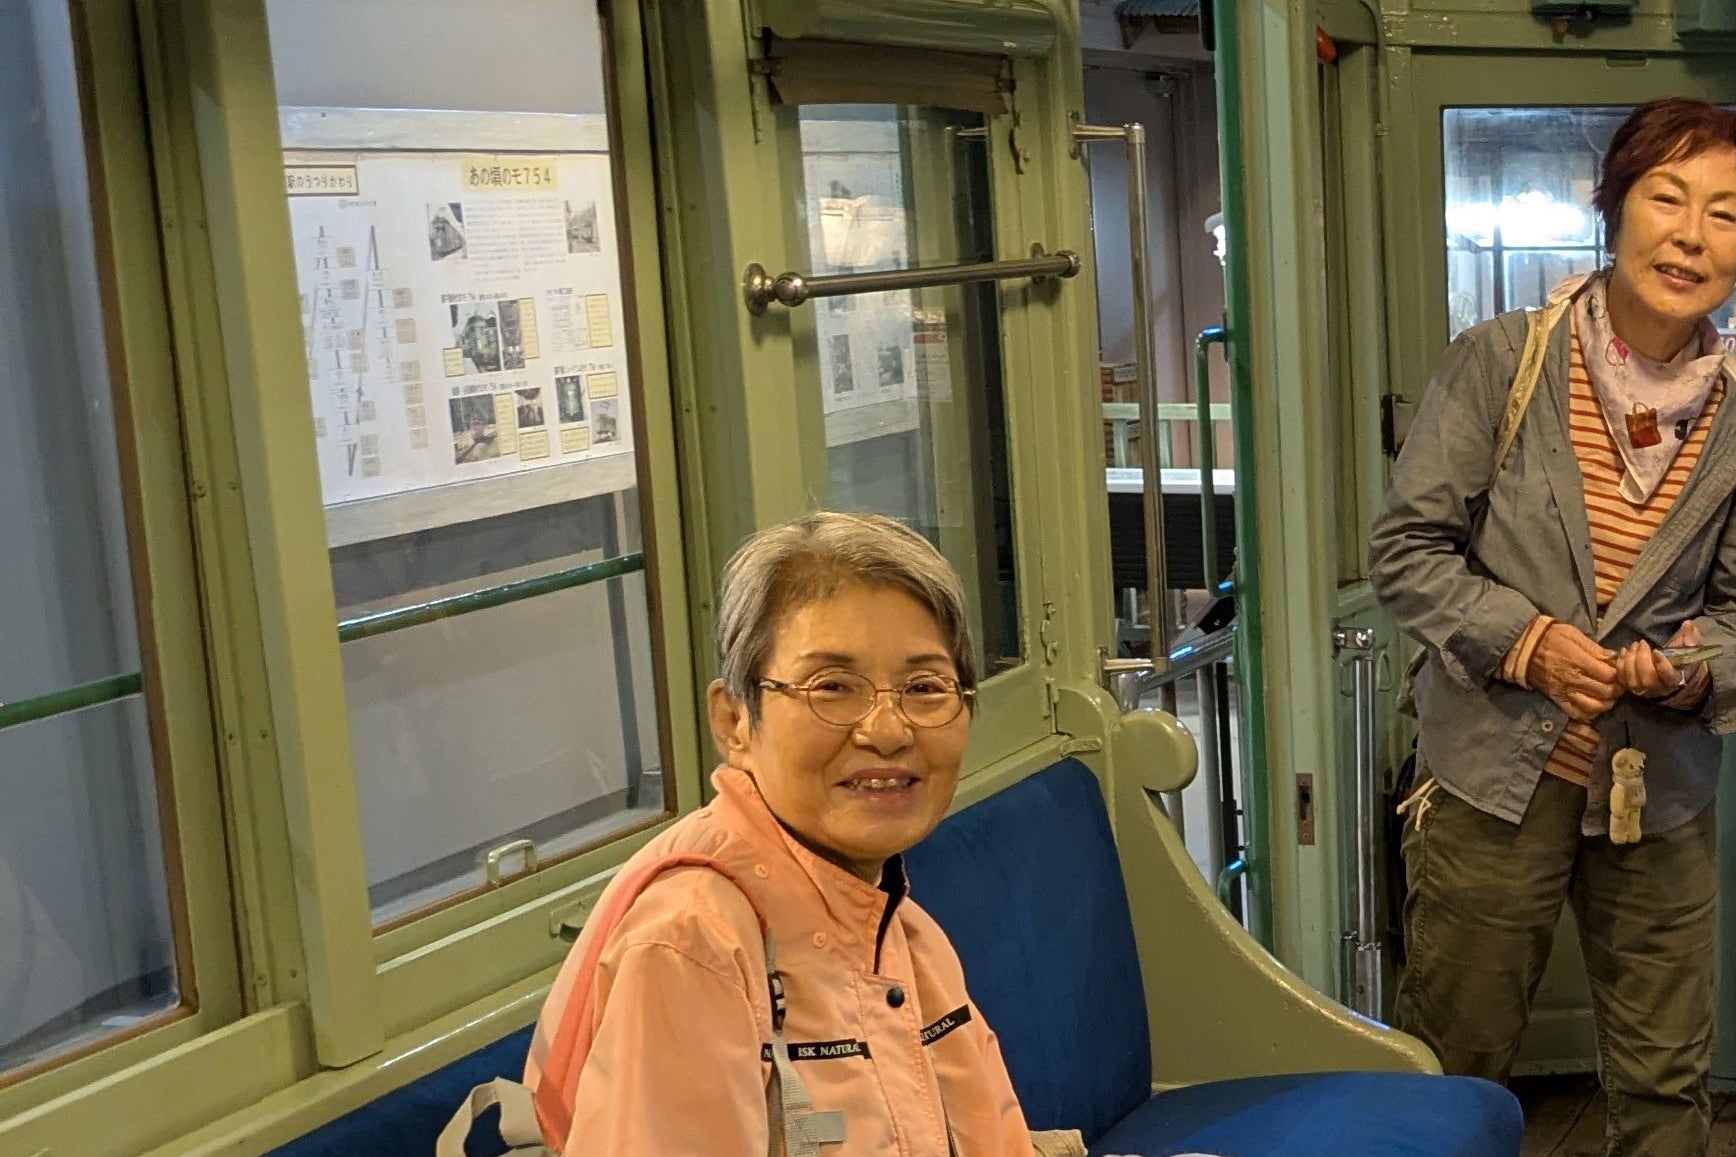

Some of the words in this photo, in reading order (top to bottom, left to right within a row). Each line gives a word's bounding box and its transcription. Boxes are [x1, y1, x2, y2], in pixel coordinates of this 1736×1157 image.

[469, 166, 551, 187] あの頃のモ754
[798, 1046, 817, 1057] ISK
